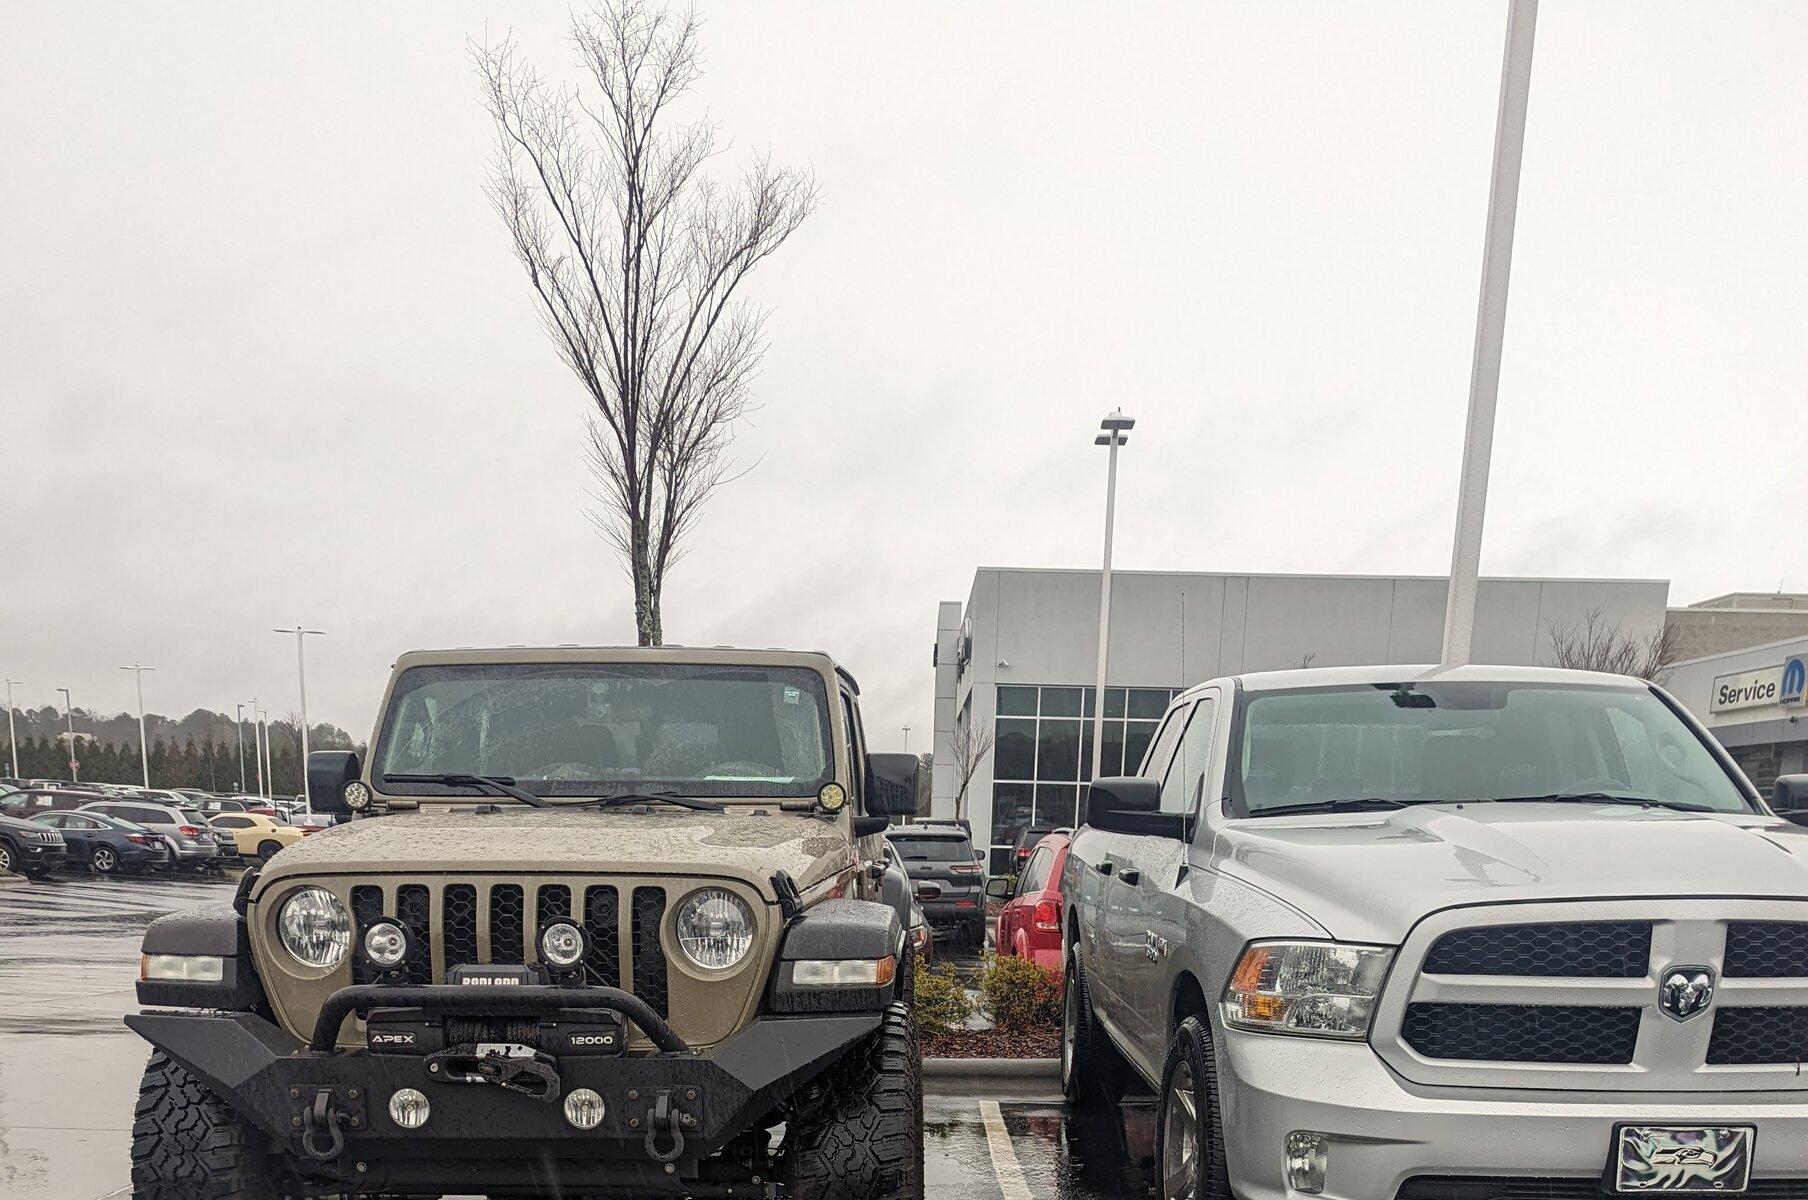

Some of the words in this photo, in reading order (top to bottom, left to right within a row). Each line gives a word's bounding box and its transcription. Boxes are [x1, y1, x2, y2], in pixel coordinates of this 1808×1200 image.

[1718, 680, 1776, 705] Service
[371, 1034, 415, 1043] APEX
[570, 1036, 614, 1045] 12000
